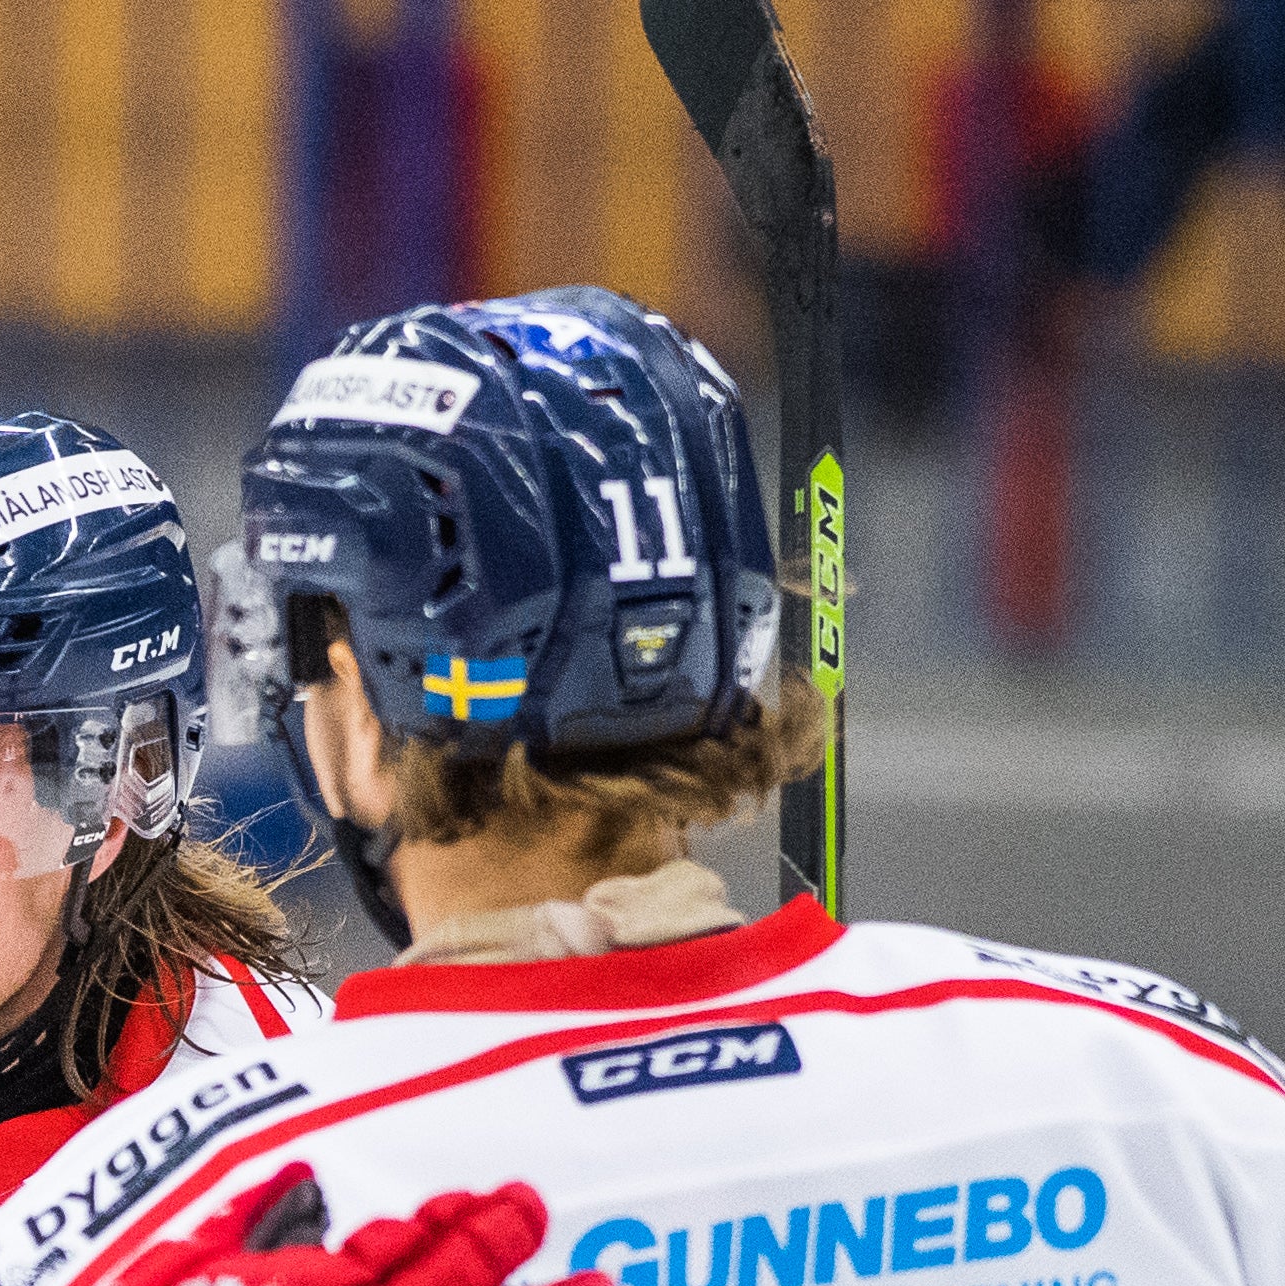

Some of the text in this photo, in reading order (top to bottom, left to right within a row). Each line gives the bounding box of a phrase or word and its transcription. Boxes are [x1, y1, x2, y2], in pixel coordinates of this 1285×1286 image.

[260, 532, 336, 562] CCM
[599, 475, 698, 582] 11
[816, 482, 842, 672] CCM
[579, 1027, 785, 1092] CCM
